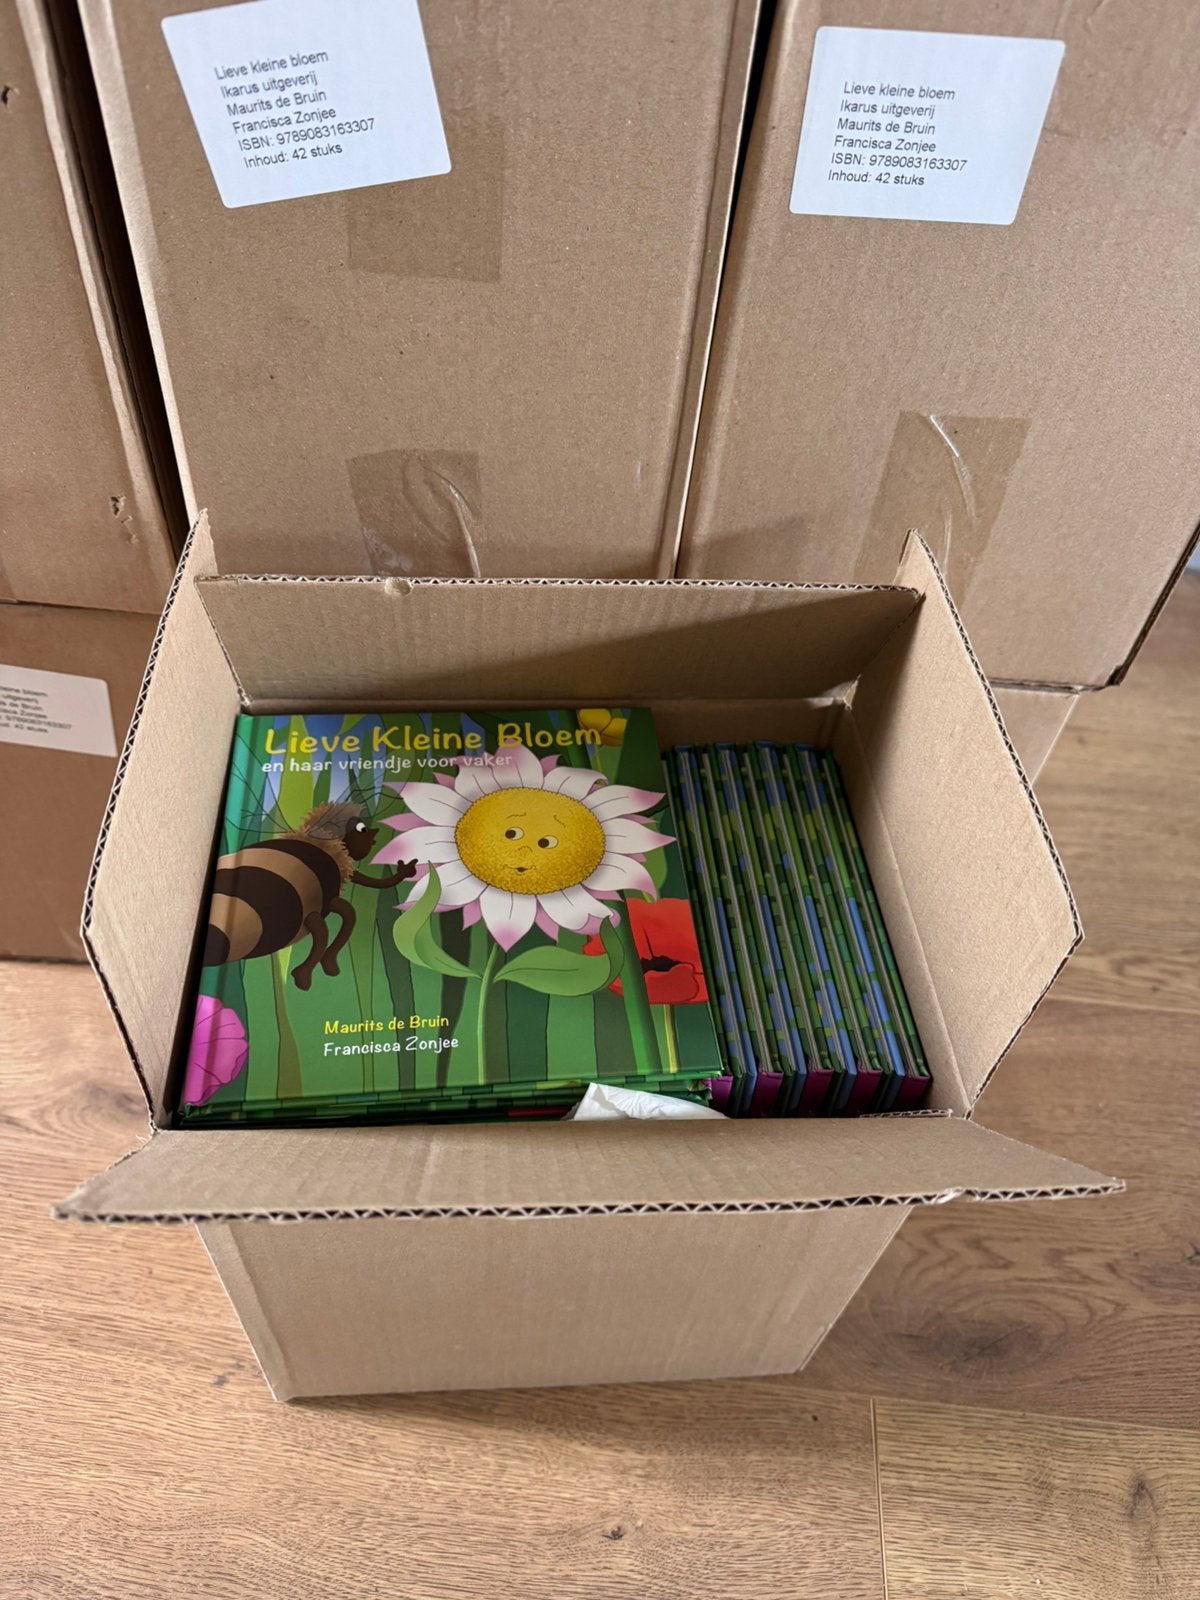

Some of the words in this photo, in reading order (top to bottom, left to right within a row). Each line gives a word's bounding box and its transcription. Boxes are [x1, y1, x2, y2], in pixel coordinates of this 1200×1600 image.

[214, 64, 248, 80] Lieve
[250, 57, 288, 75] kleine
[290, 50, 329, 67] bloem
[221, 82, 259, 98] Ikarus
[263, 71, 318, 92] uitgeverij
[844, 82, 875, 95] Lieve
[879, 84, 915, 97] kleine
[919, 86, 955, 100] bloem
[227, 100, 273, 116] Maurits
[276, 95, 291, 108] de
[294, 90, 327, 105] Bruin
[840, 100, 877, 113] Ikarus
[881, 102, 935, 119] uitgeverij
[233, 115, 291, 134] Francisca
[295, 108, 337, 125] Zonjee
[837, 118, 881, 132] Maurits
[886, 121, 900, 132] de
[904, 122, 935, 135] Bruin
[239, 136, 274, 151] ISBN:
[277, 118, 375, 145] 9789083163307
[834, 136, 892, 150] Francisca
[895, 139, 936, 154] Zonjee
[244, 152, 289, 168] Inhoud:
[292, 148, 307, 161] 42
[311, 144, 343, 157] stuks
[831, 153, 865, 165] ISBN:
[869, 155, 967, 172] 9789083163307
[828, 170, 871, 183] Inhoud:
[875, 173, 890, 184] 42
[893, 174, 925, 186] stuks
[265, 729, 360, 756] Lieve
[373, 725, 483, 752] Kleine
[498, 723, 602, 748] Bloem
[262, 761, 283, 773] en
[290, 757, 332, 773] haar
[338, 758, 411, 771] vriendje
[417, 757, 457, 769] voor
[463, 753, 513, 768] vaker
[325, 1020, 383, 1034] Maurits
[388, 1017, 405, 1030] de
[410, 1014, 449, 1029] Bruin
[324, 1041, 401, 1056] Francisca
[406, 1036, 459, 1055] Zonjee
